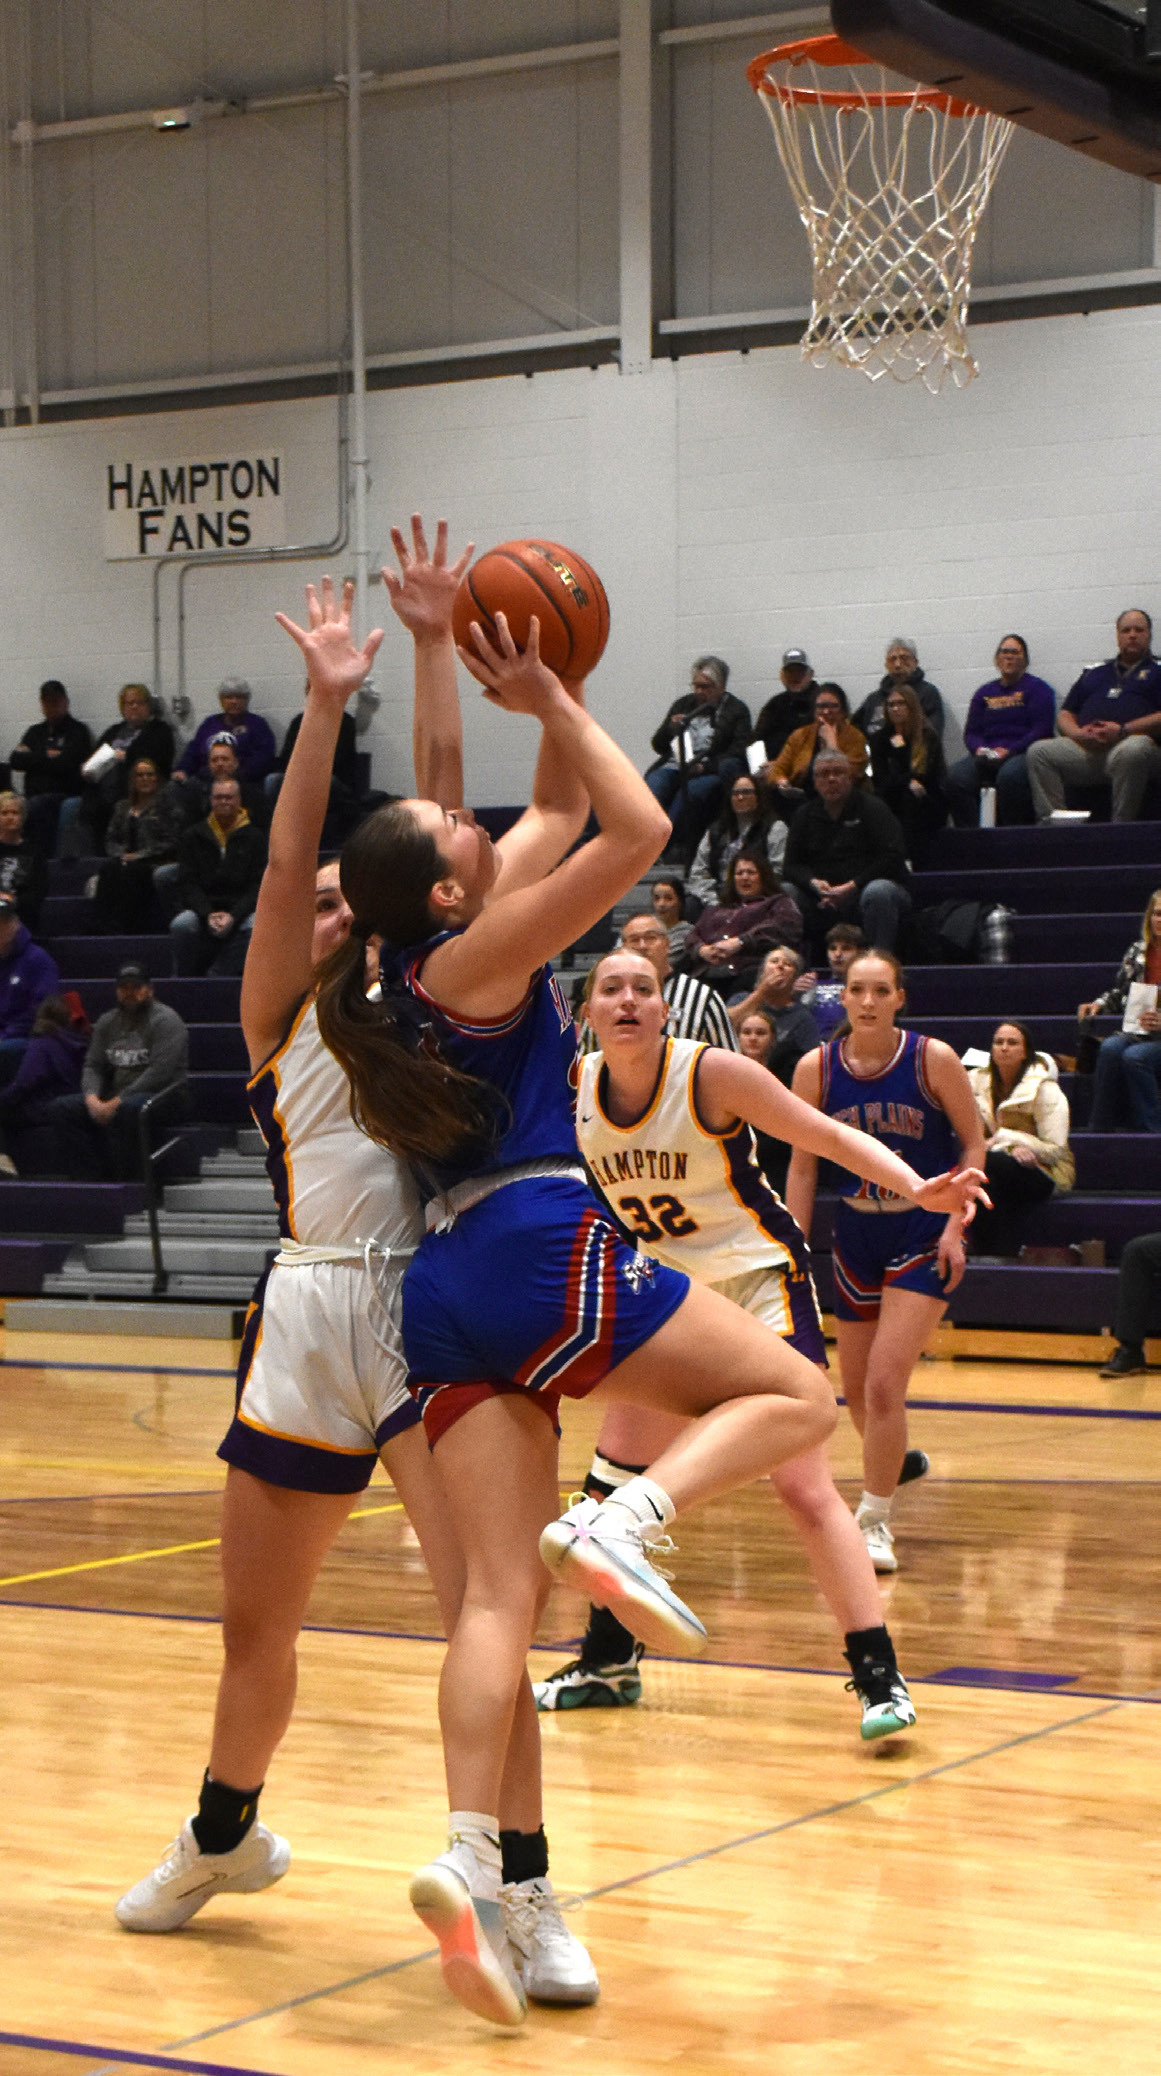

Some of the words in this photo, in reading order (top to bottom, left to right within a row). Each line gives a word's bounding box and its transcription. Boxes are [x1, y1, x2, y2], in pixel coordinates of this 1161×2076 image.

[108, 457, 280, 510] HAMPTON
[138, 509, 251, 554] FANS
[864, 1101, 925, 1141] PLAINS
[618, 1194, 700, 1243] 32
